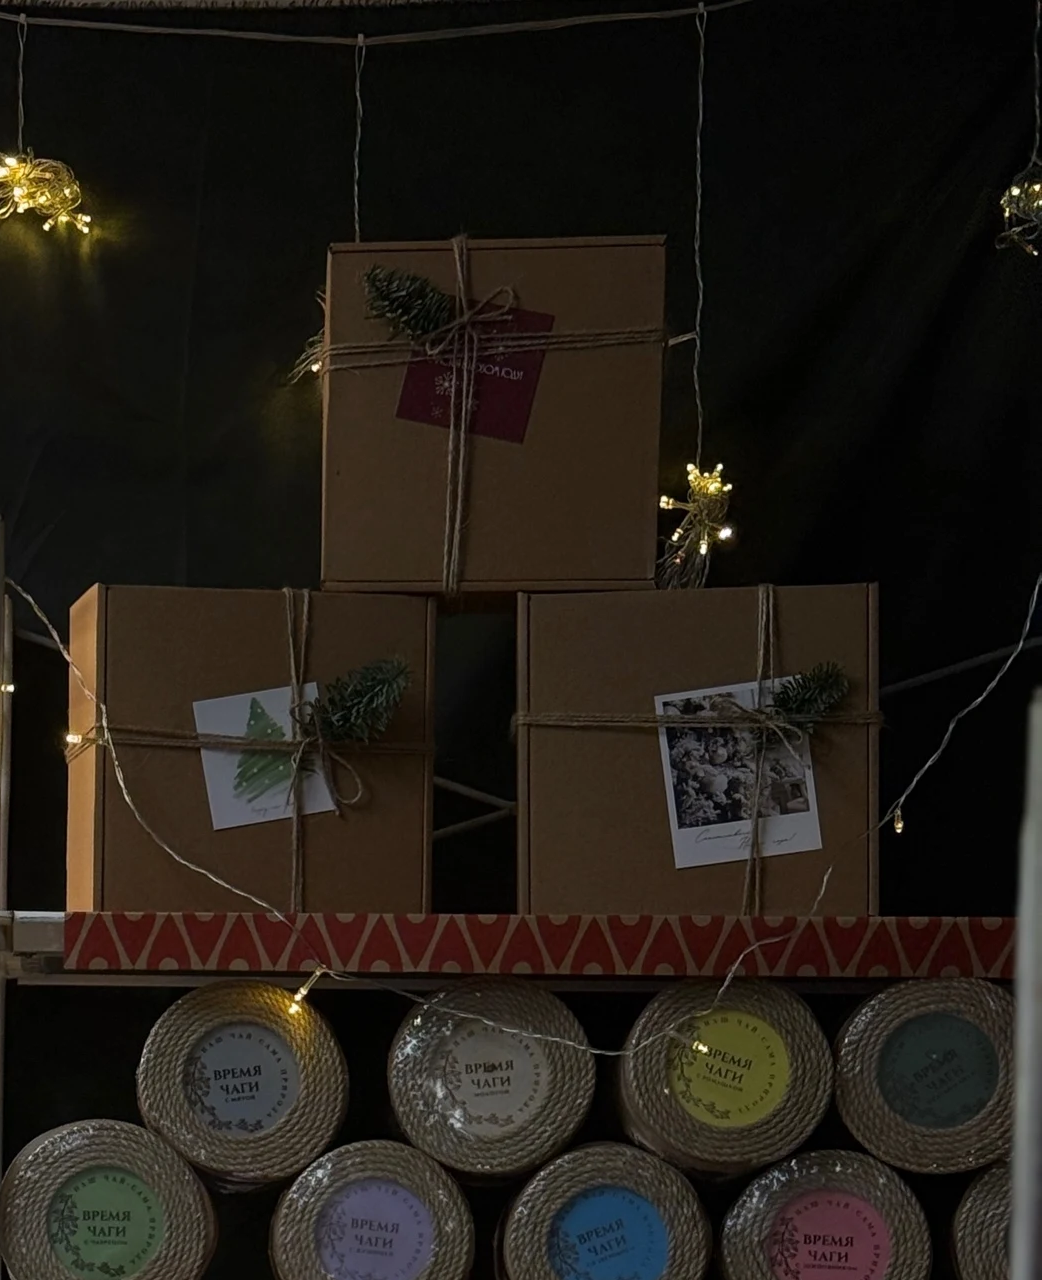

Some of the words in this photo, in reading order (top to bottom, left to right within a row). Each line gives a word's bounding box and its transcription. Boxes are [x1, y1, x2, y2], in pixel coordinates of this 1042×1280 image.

[213, 1065, 262, 1081] ВРЕМЯ
[464, 1060, 514, 1074] ВРЕМЯ
[705, 1062, 744, 1084] ЧАГИ
[220, 1081, 259, 1095] ЧАГИ
[471, 1076, 511, 1089] ЧАГИ
[82, 1210, 131, 1222] ВРЕМЯ
[87, 1226, 126, 1237] ЧАГИ
[351, 1218, 400, 1234] ВРЕМЯ
[576, 1218, 624, 1245] ВРЕМЯ
[354, 1234, 393, 1248] ЧАГИ
[587, 1234, 627, 1256] ЧАГИ
[803, 1233, 855, 1248] ВРЕМЯ
[807, 1249, 849, 1263] ЧАГИ
